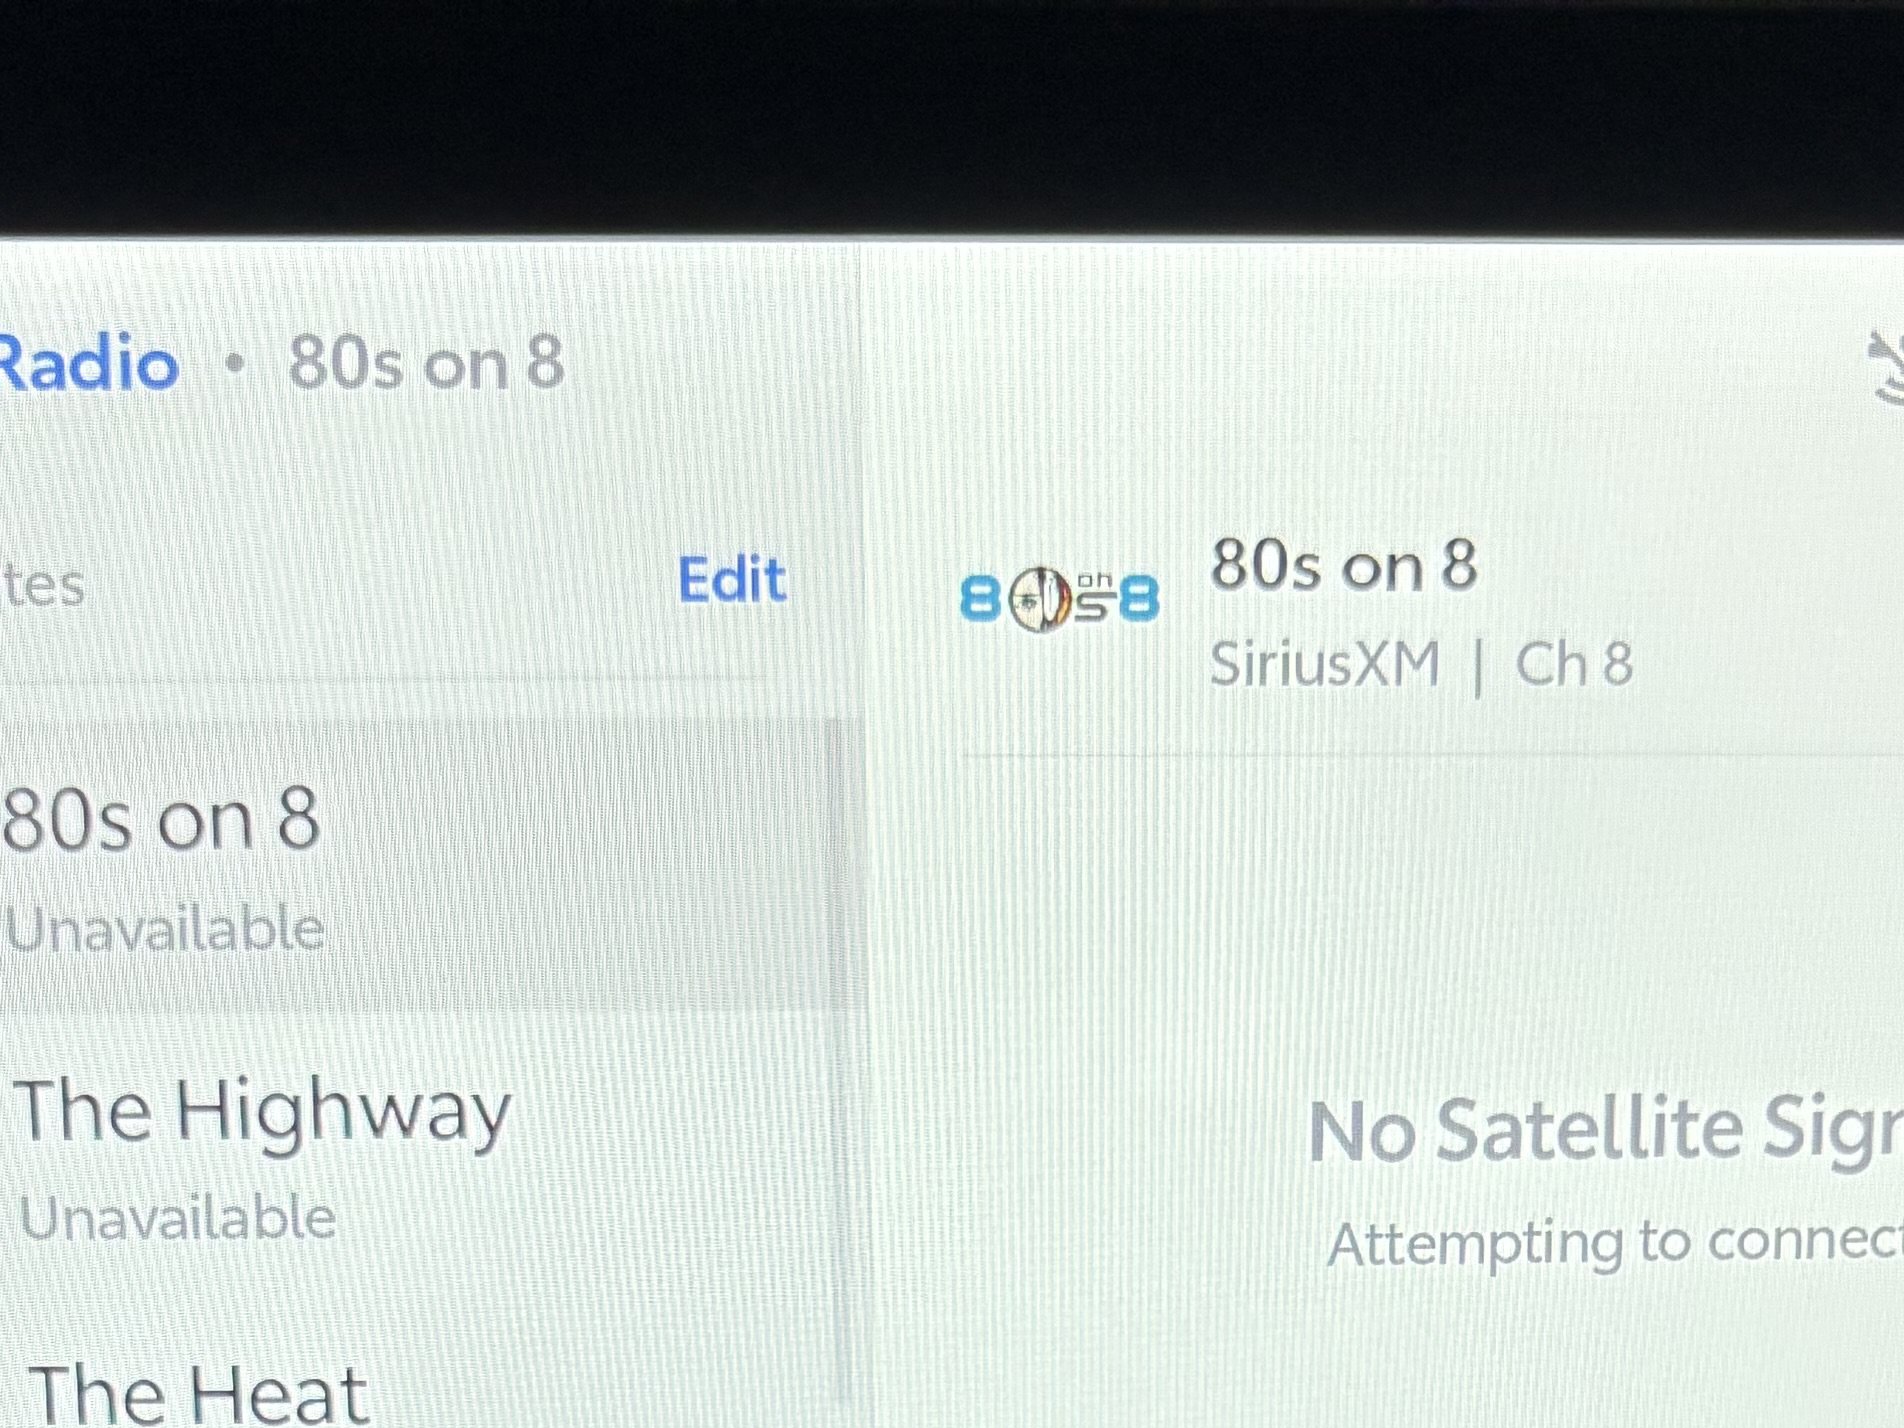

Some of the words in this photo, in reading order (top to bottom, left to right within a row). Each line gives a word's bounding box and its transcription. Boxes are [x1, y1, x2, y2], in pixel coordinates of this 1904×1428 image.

[288, 331, 402, 391] 80s
[424, 348, 506, 390] on
[526, 331, 566, 390] 8
[678, 554, 787, 606] Edit
[1211, 537, 1322, 594] 80s
[1342, 550, 1424, 591] on
[1441, 537, 1479, 591] 8
[1210, 637, 1440, 689] SiriusXM
[1516, 637, 1591, 688] Ch
[1603, 640, 1635, 688] 8
[1, 787, 132, 855] 80s
[159, 802, 253, 851] on
[278, 786, 321, 850] 8
[5, 902, 326, 956] Unavailable
[14, 1076, 153, 1144] The
[176, 1075, 513, 1157] Highway
[1308, 1100, 1417, 1165] No
[1436, 1092, 1742, 1161] Satellite
[20, 1191, 338, 1245] Unavailable
[1327, 1219, 1624, 1272] Attempting
[1640, 1222, 1692, 1262] to
[29, 1364, 166, 1428] The
[190, 1361, 371, 1427] Heat
